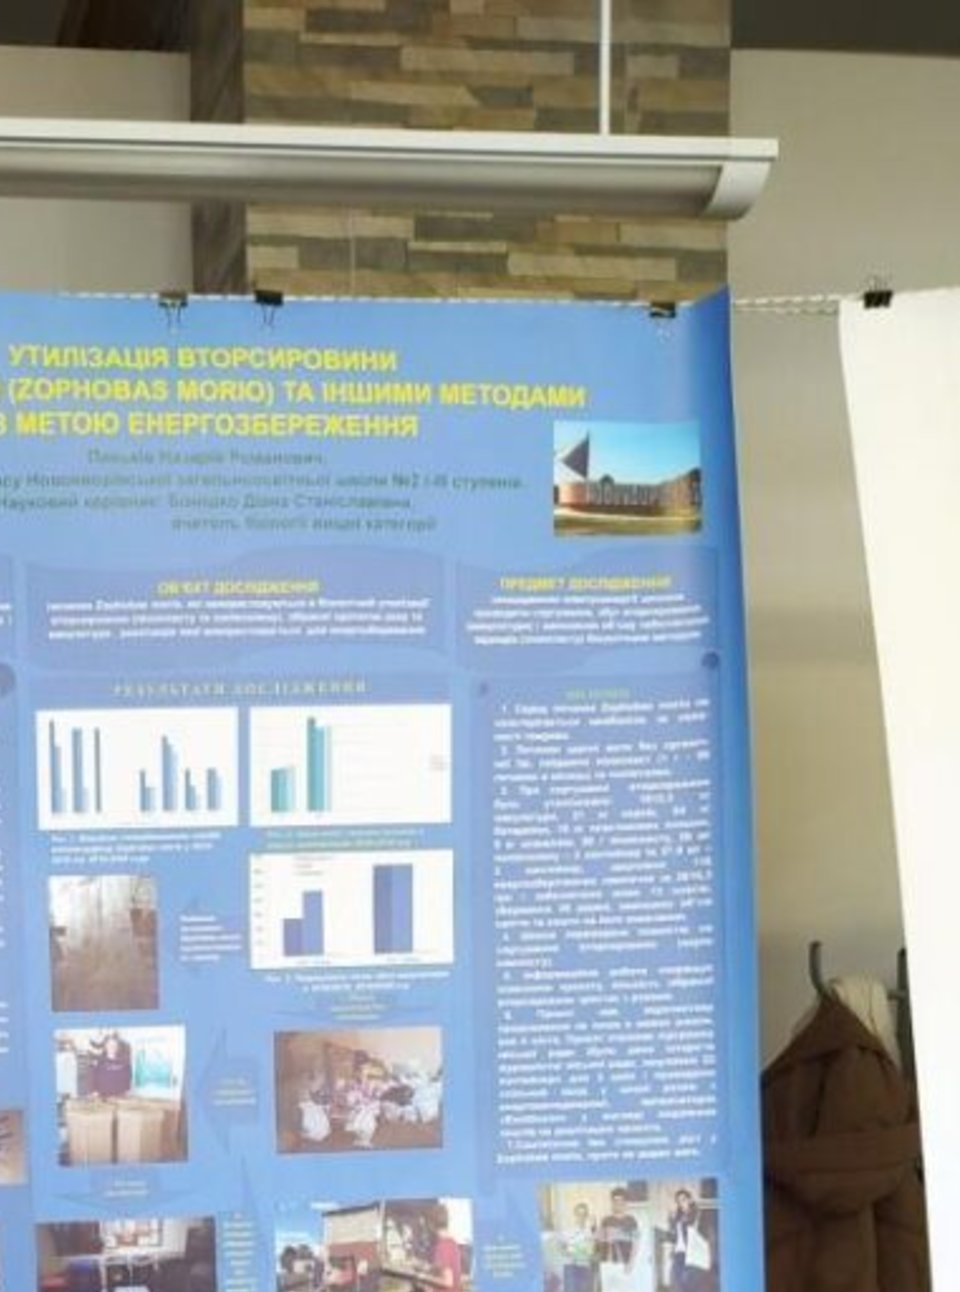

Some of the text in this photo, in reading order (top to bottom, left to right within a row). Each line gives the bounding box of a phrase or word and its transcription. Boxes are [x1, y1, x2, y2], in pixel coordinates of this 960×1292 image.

[8, 344, 396, 371] УТИЛІЗАЦІЯ ВТОРСИРОВИНИ
[8, 378, 168, 405] (ZOPHOBAS
[178, 380, 273, 405] MORIO)
[284, 381, 316, 403] ТА
[321, 381, 432, 404] ІНШИМИ
[440, 382, 586, 409] МЕТОДАМИ
[15, 411, 119, 436] МЕТОЮ
[129, 412, 418, 438] ЕНЕРГОЗБЕРЕЖЕННЯ
